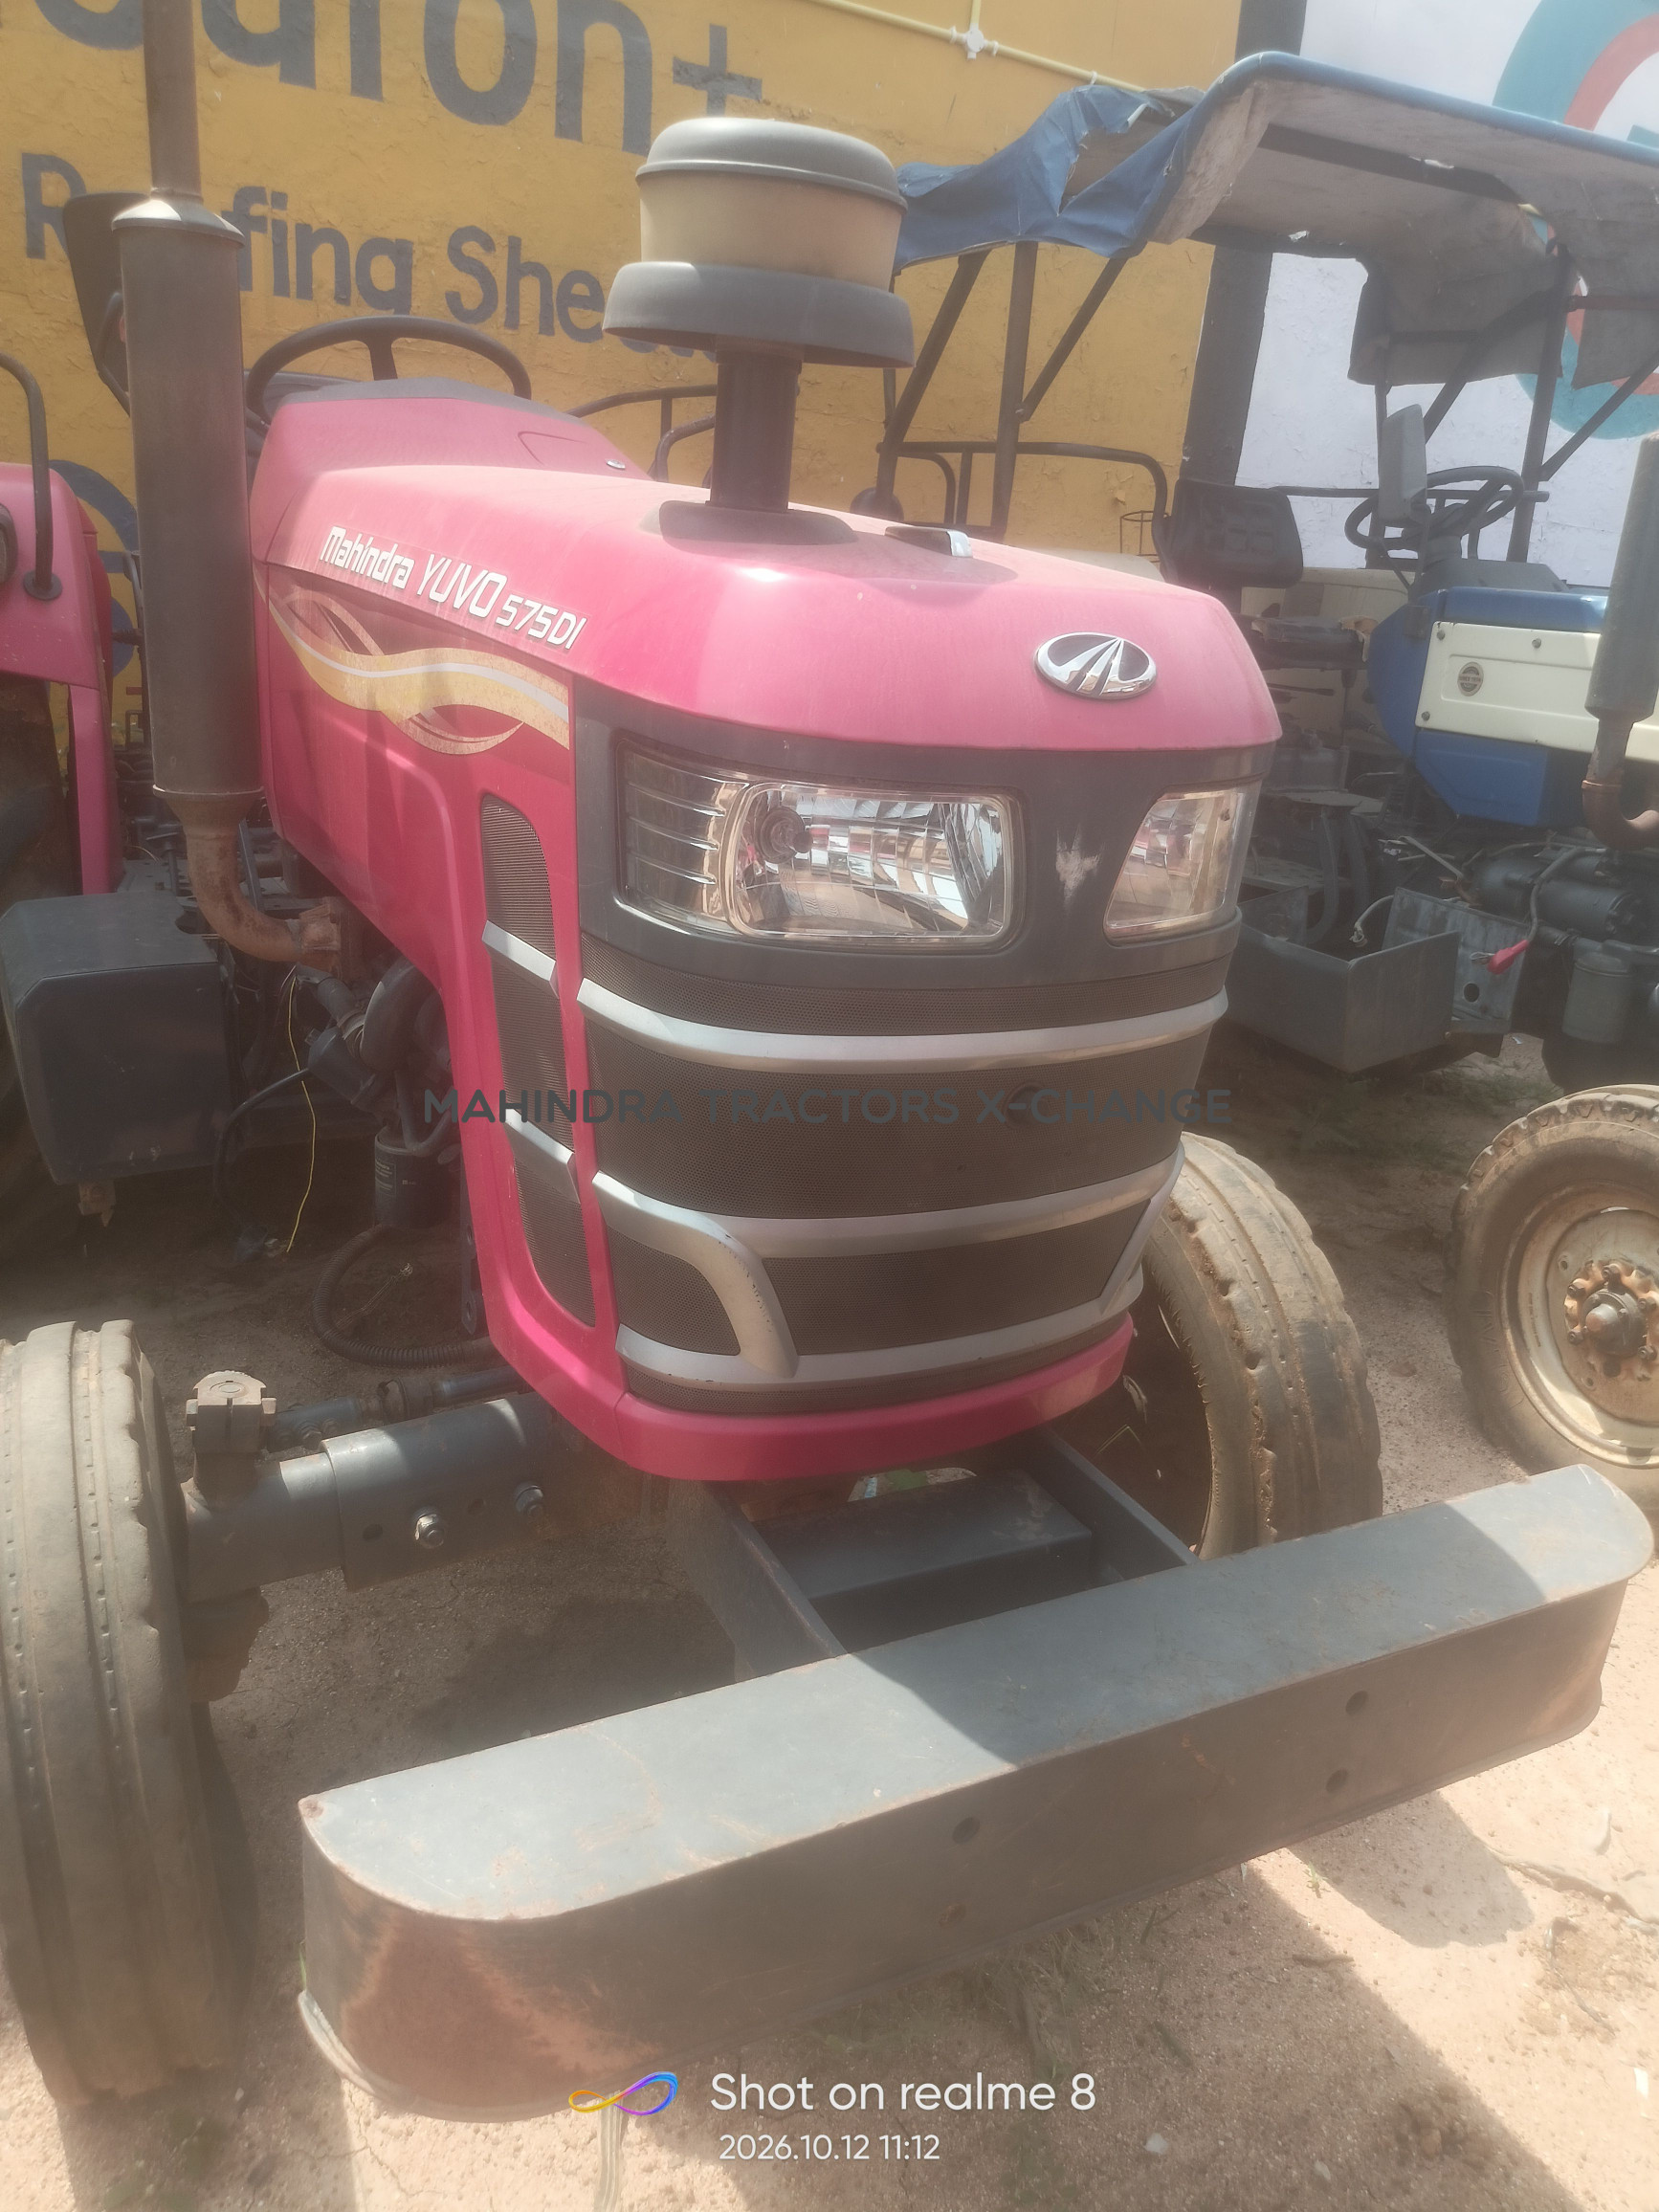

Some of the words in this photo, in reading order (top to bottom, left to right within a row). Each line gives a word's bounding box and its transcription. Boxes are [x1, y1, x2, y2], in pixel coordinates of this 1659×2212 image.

[21, 152, 413, 318] Rfing
[445, 225, 718, 363] She
[320, 525, 415, 590] Mahindra
[416, 553, 508, 618] YUVO
[495, 593, 587, 651] 575DI
